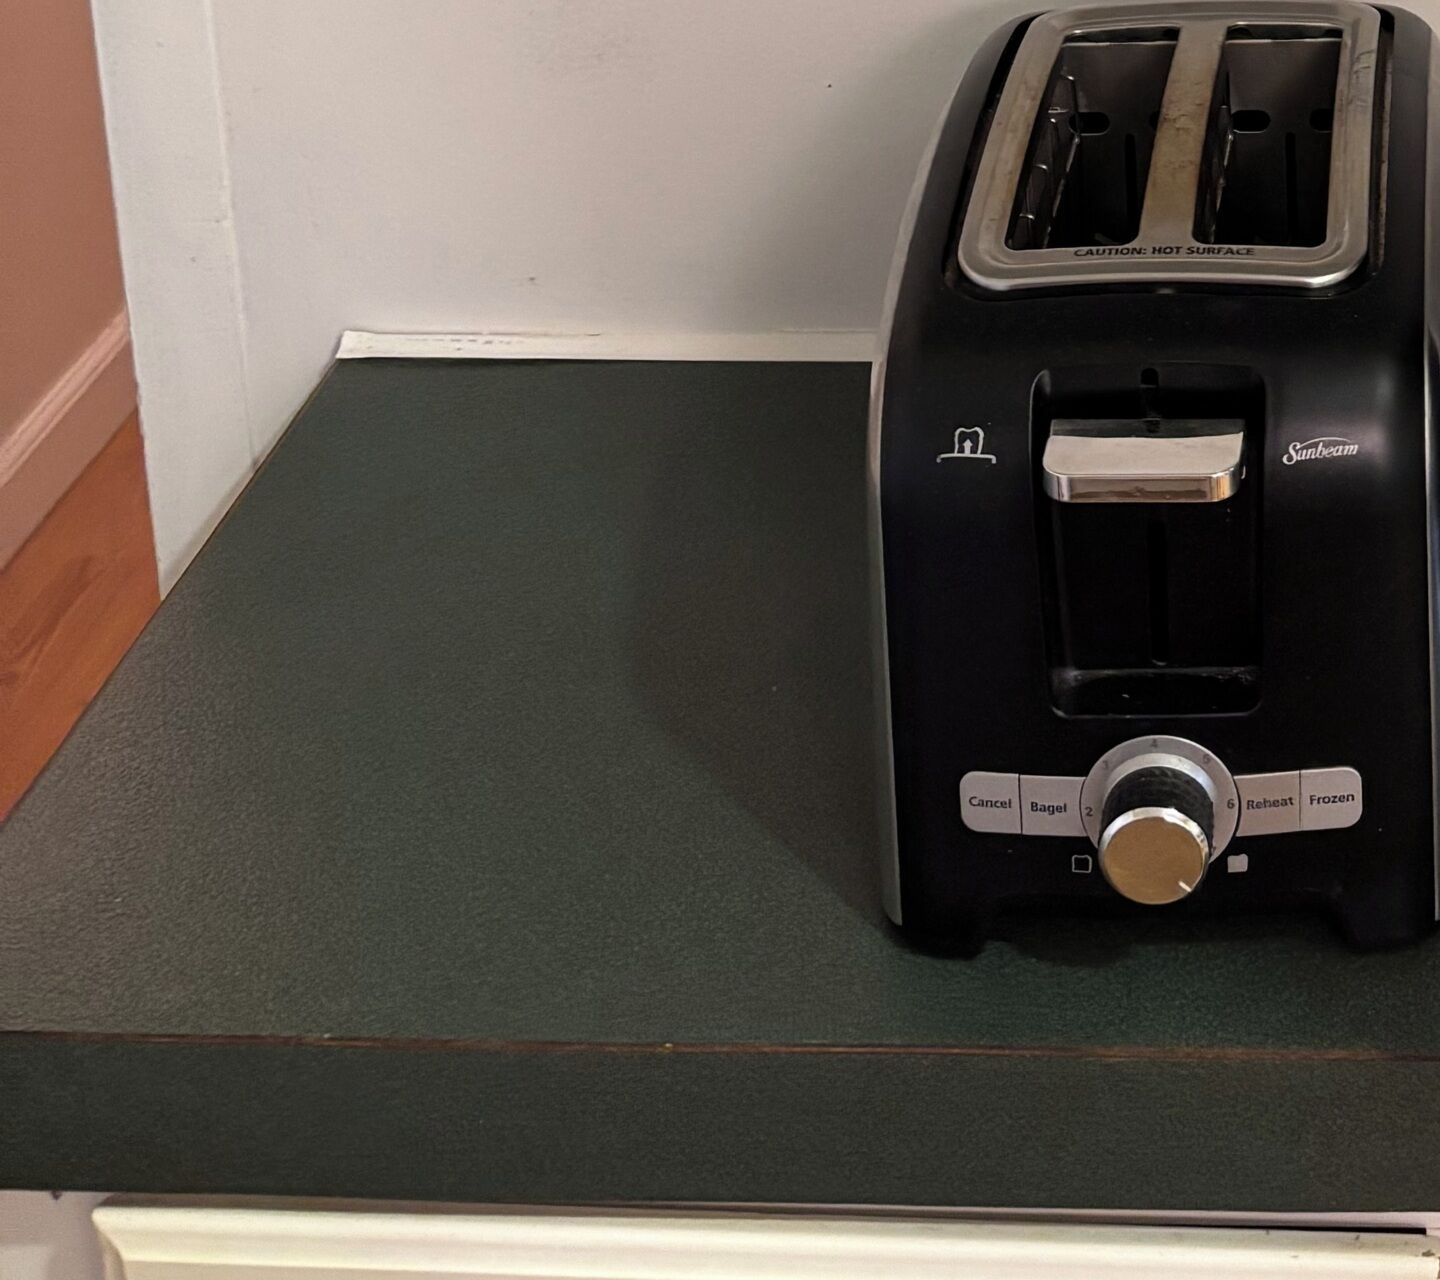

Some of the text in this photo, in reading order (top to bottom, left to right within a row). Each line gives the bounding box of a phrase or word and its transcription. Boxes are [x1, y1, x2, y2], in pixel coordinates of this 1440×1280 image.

[1073, 245, 1256, 258] CAUTION: HOT SURFACE
[1281, 437, 1360, 466] Sunbeam
[968, 795, 1013, 810] Cancel
[1226, 798, 1236, 810] 6
[1245, 796, 1295, 811] Reheat
[1308, 792, 1356, 806] Frozen
[1029, 801, 1068, 816] Bagel
[1084, 806, 1094, 818] 2
